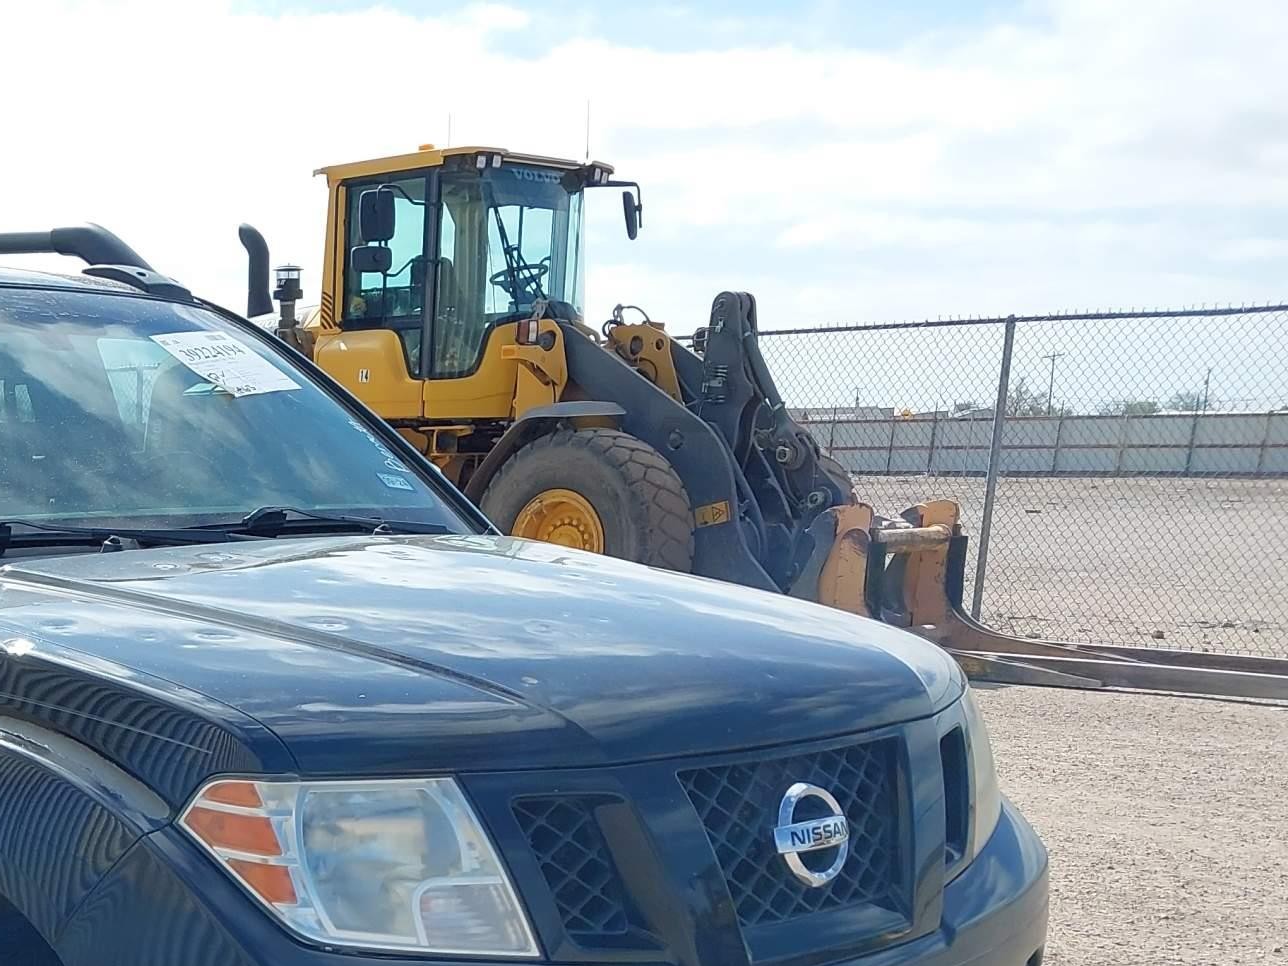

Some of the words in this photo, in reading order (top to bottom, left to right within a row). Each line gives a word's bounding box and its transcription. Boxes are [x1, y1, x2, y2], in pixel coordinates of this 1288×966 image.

[511, 168, 562, 184] VOLVO
[178, 343, 247, 362] 39224194
[790, 820, 849, 847] NISSAN
